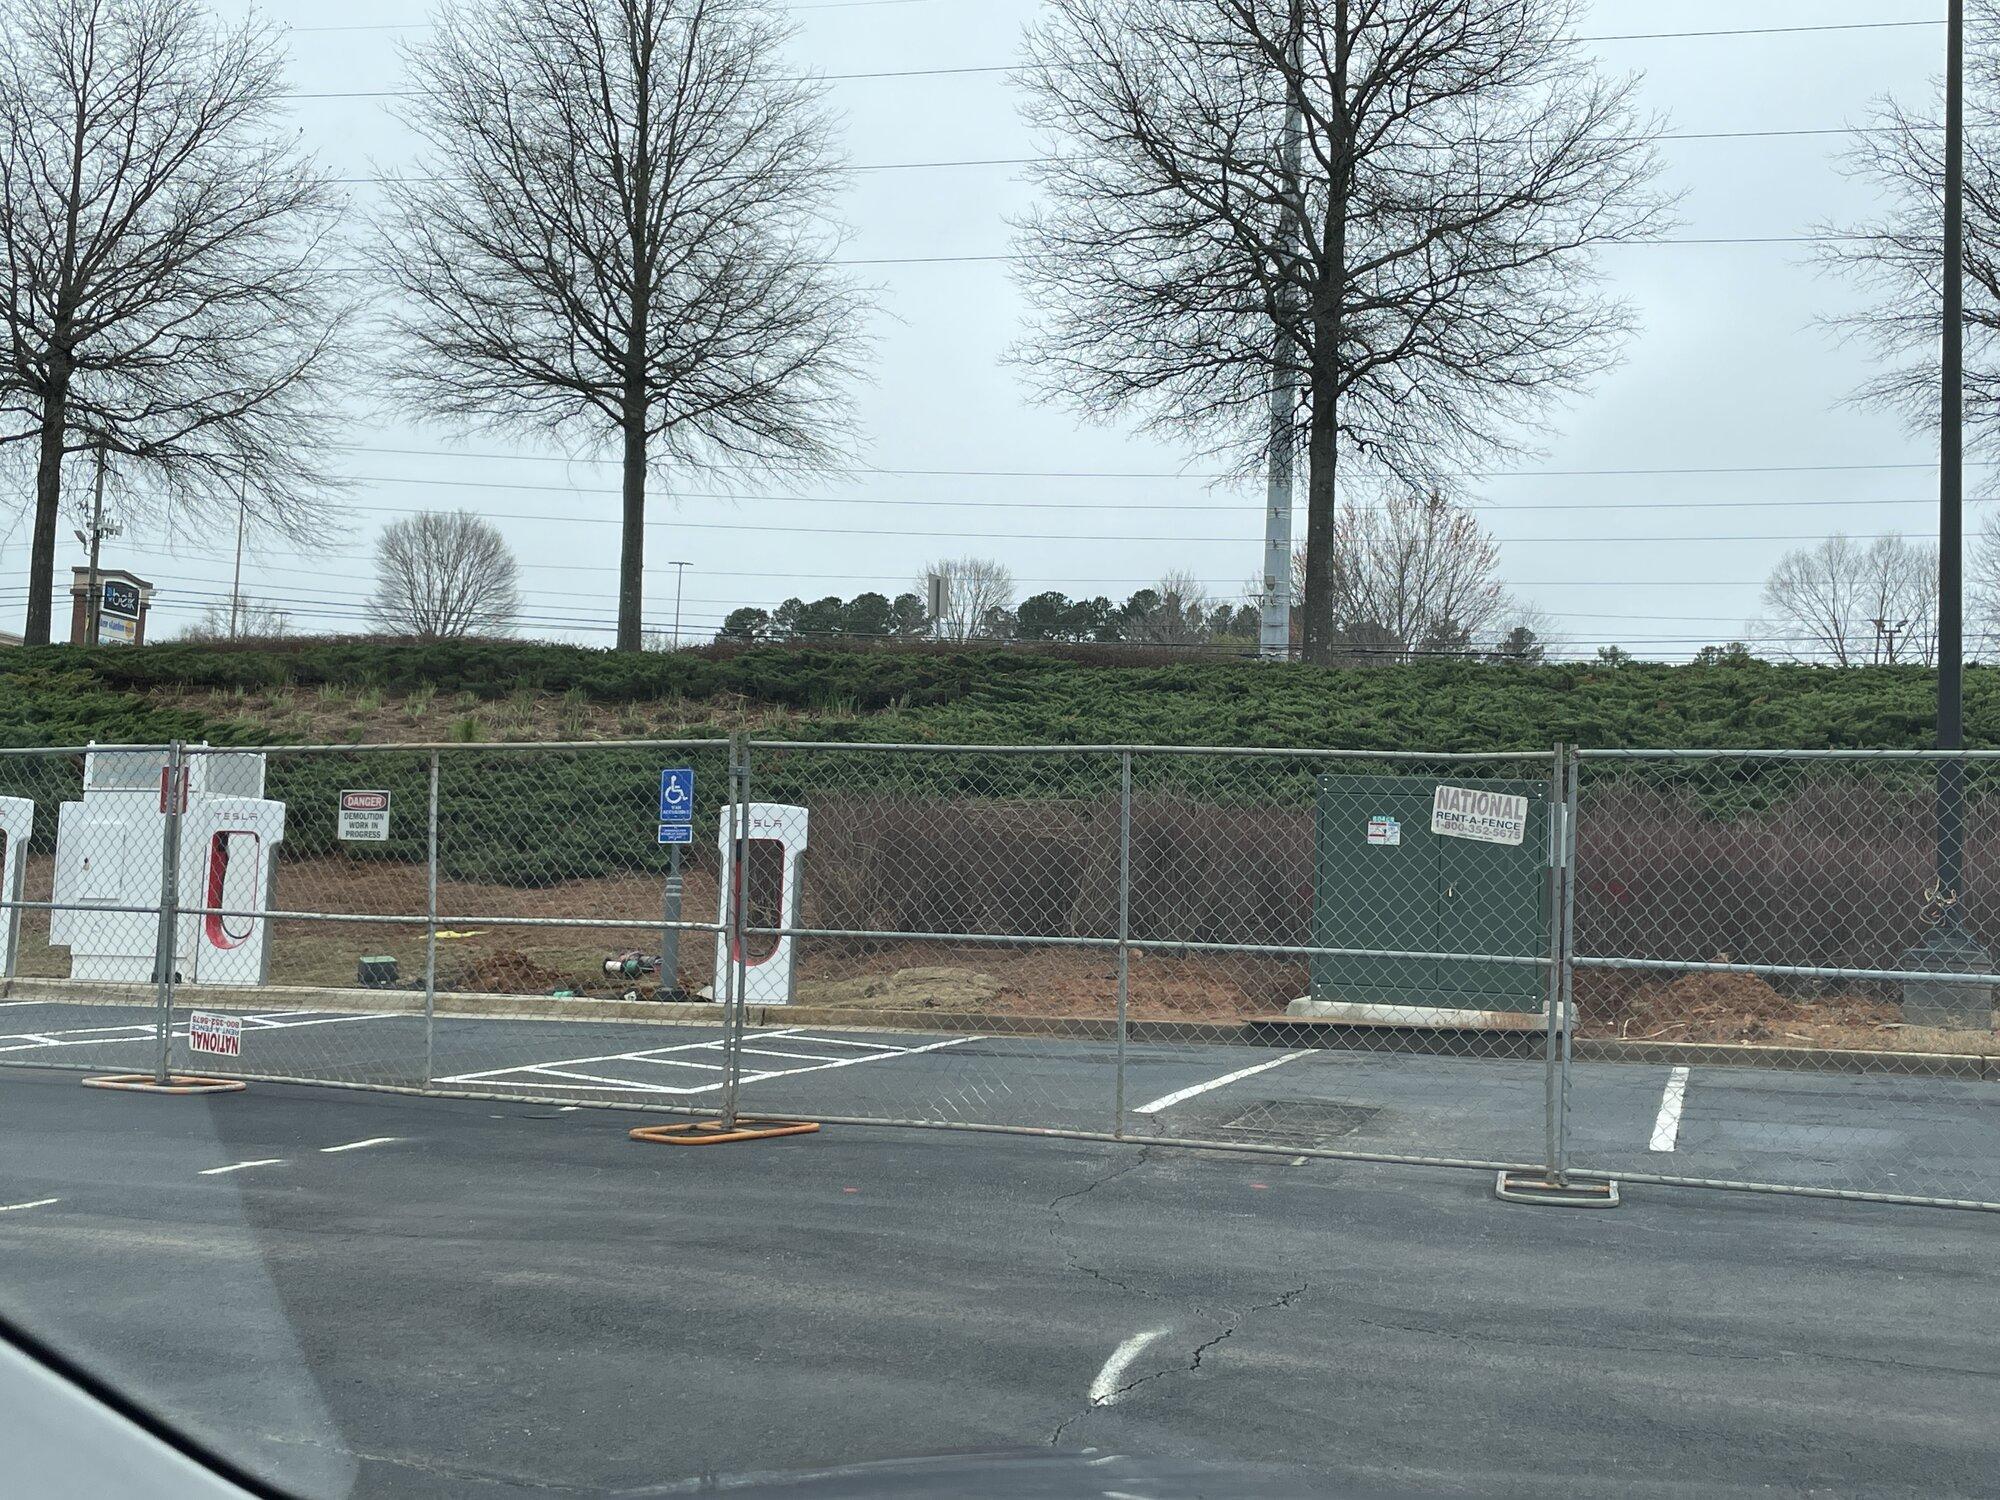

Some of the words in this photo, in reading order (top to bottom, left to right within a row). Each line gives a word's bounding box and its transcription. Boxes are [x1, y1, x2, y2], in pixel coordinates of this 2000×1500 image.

[347, 796, 382, 807] DANGER
[1437, 788, 1524, 820] NATIONAL
[214, 812, 258, 821] TESLA
[344, 812, 385, 821] DEMOLITION
[1436, 811, 1523, 830] RENT-A-FENCE
[349, 821, 369, 829] WORK
[371, 821, 379, 829] IN
[1435, 820, 1521, 840] 1-800-352-5675
[345, 830, 381, 839] PROGRESS
[191, 1030, 239, 1054] NATIONAL
